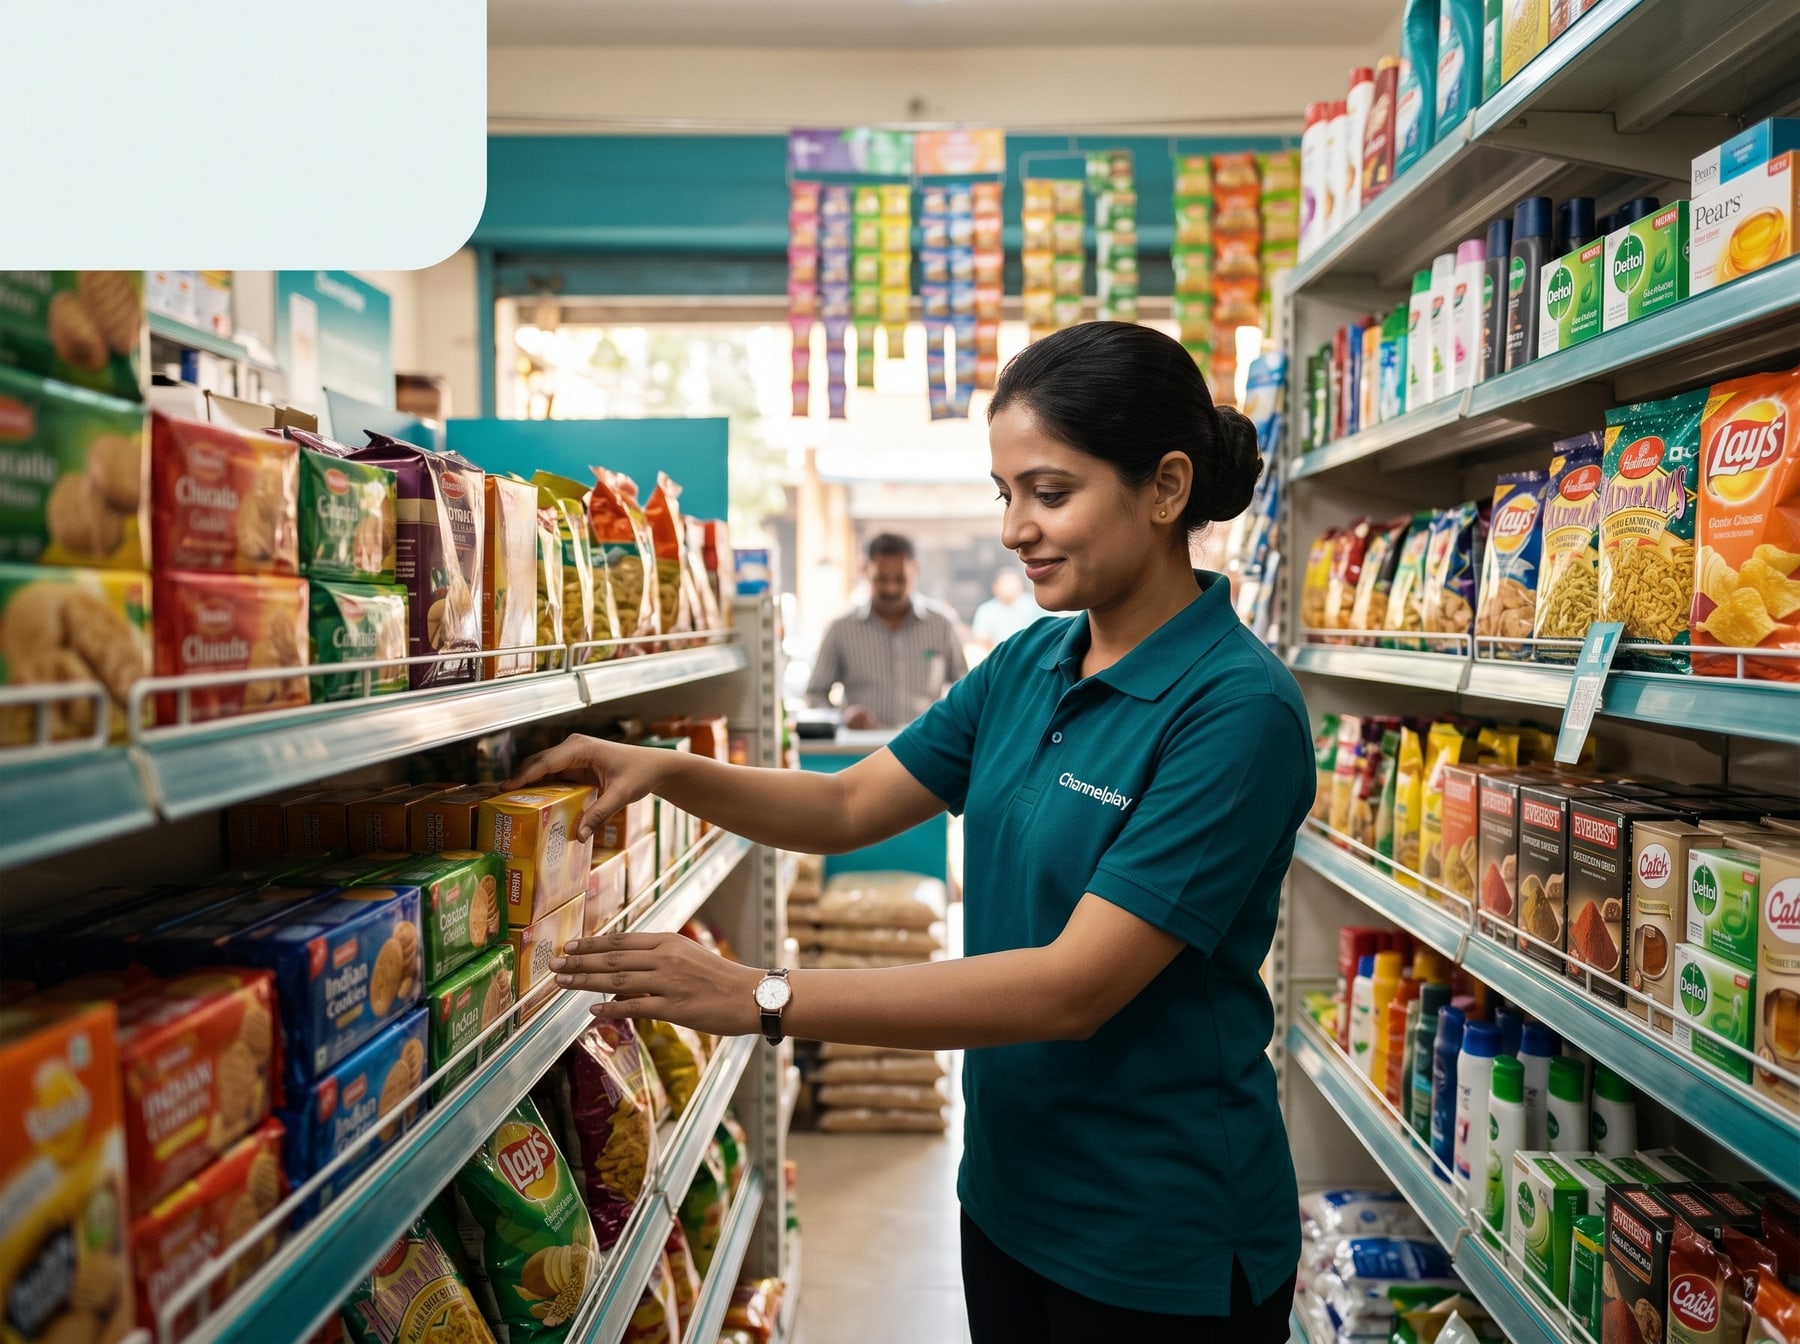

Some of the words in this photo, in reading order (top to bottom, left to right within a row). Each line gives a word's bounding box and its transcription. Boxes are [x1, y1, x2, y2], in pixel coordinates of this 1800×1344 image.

[1694, 164, 1717, 184] Pears
[1694, 196, 1741, 231] Pears
[1614, 250, 1643, 277] Dettol
[1548, 281, 1571, 305] Dettol
[1709, 419, 1784, 477] Lay's
[1059, 772, 1133, 811] Channelplay
[1574, 815, 1617, 846] EVEREST
[1639, 853, 1669, 879] Catch
[1693, 879, 1716, 901] Dettol
[1768, 890, 1800, 924] Cat
[325, 963, 368, 1001] Indian
[1680, 976, 1707, 1002] Dettol
[501, 1132, 549, 1190] Lay's
[1672, 1281, 1716, 1323] Catch
